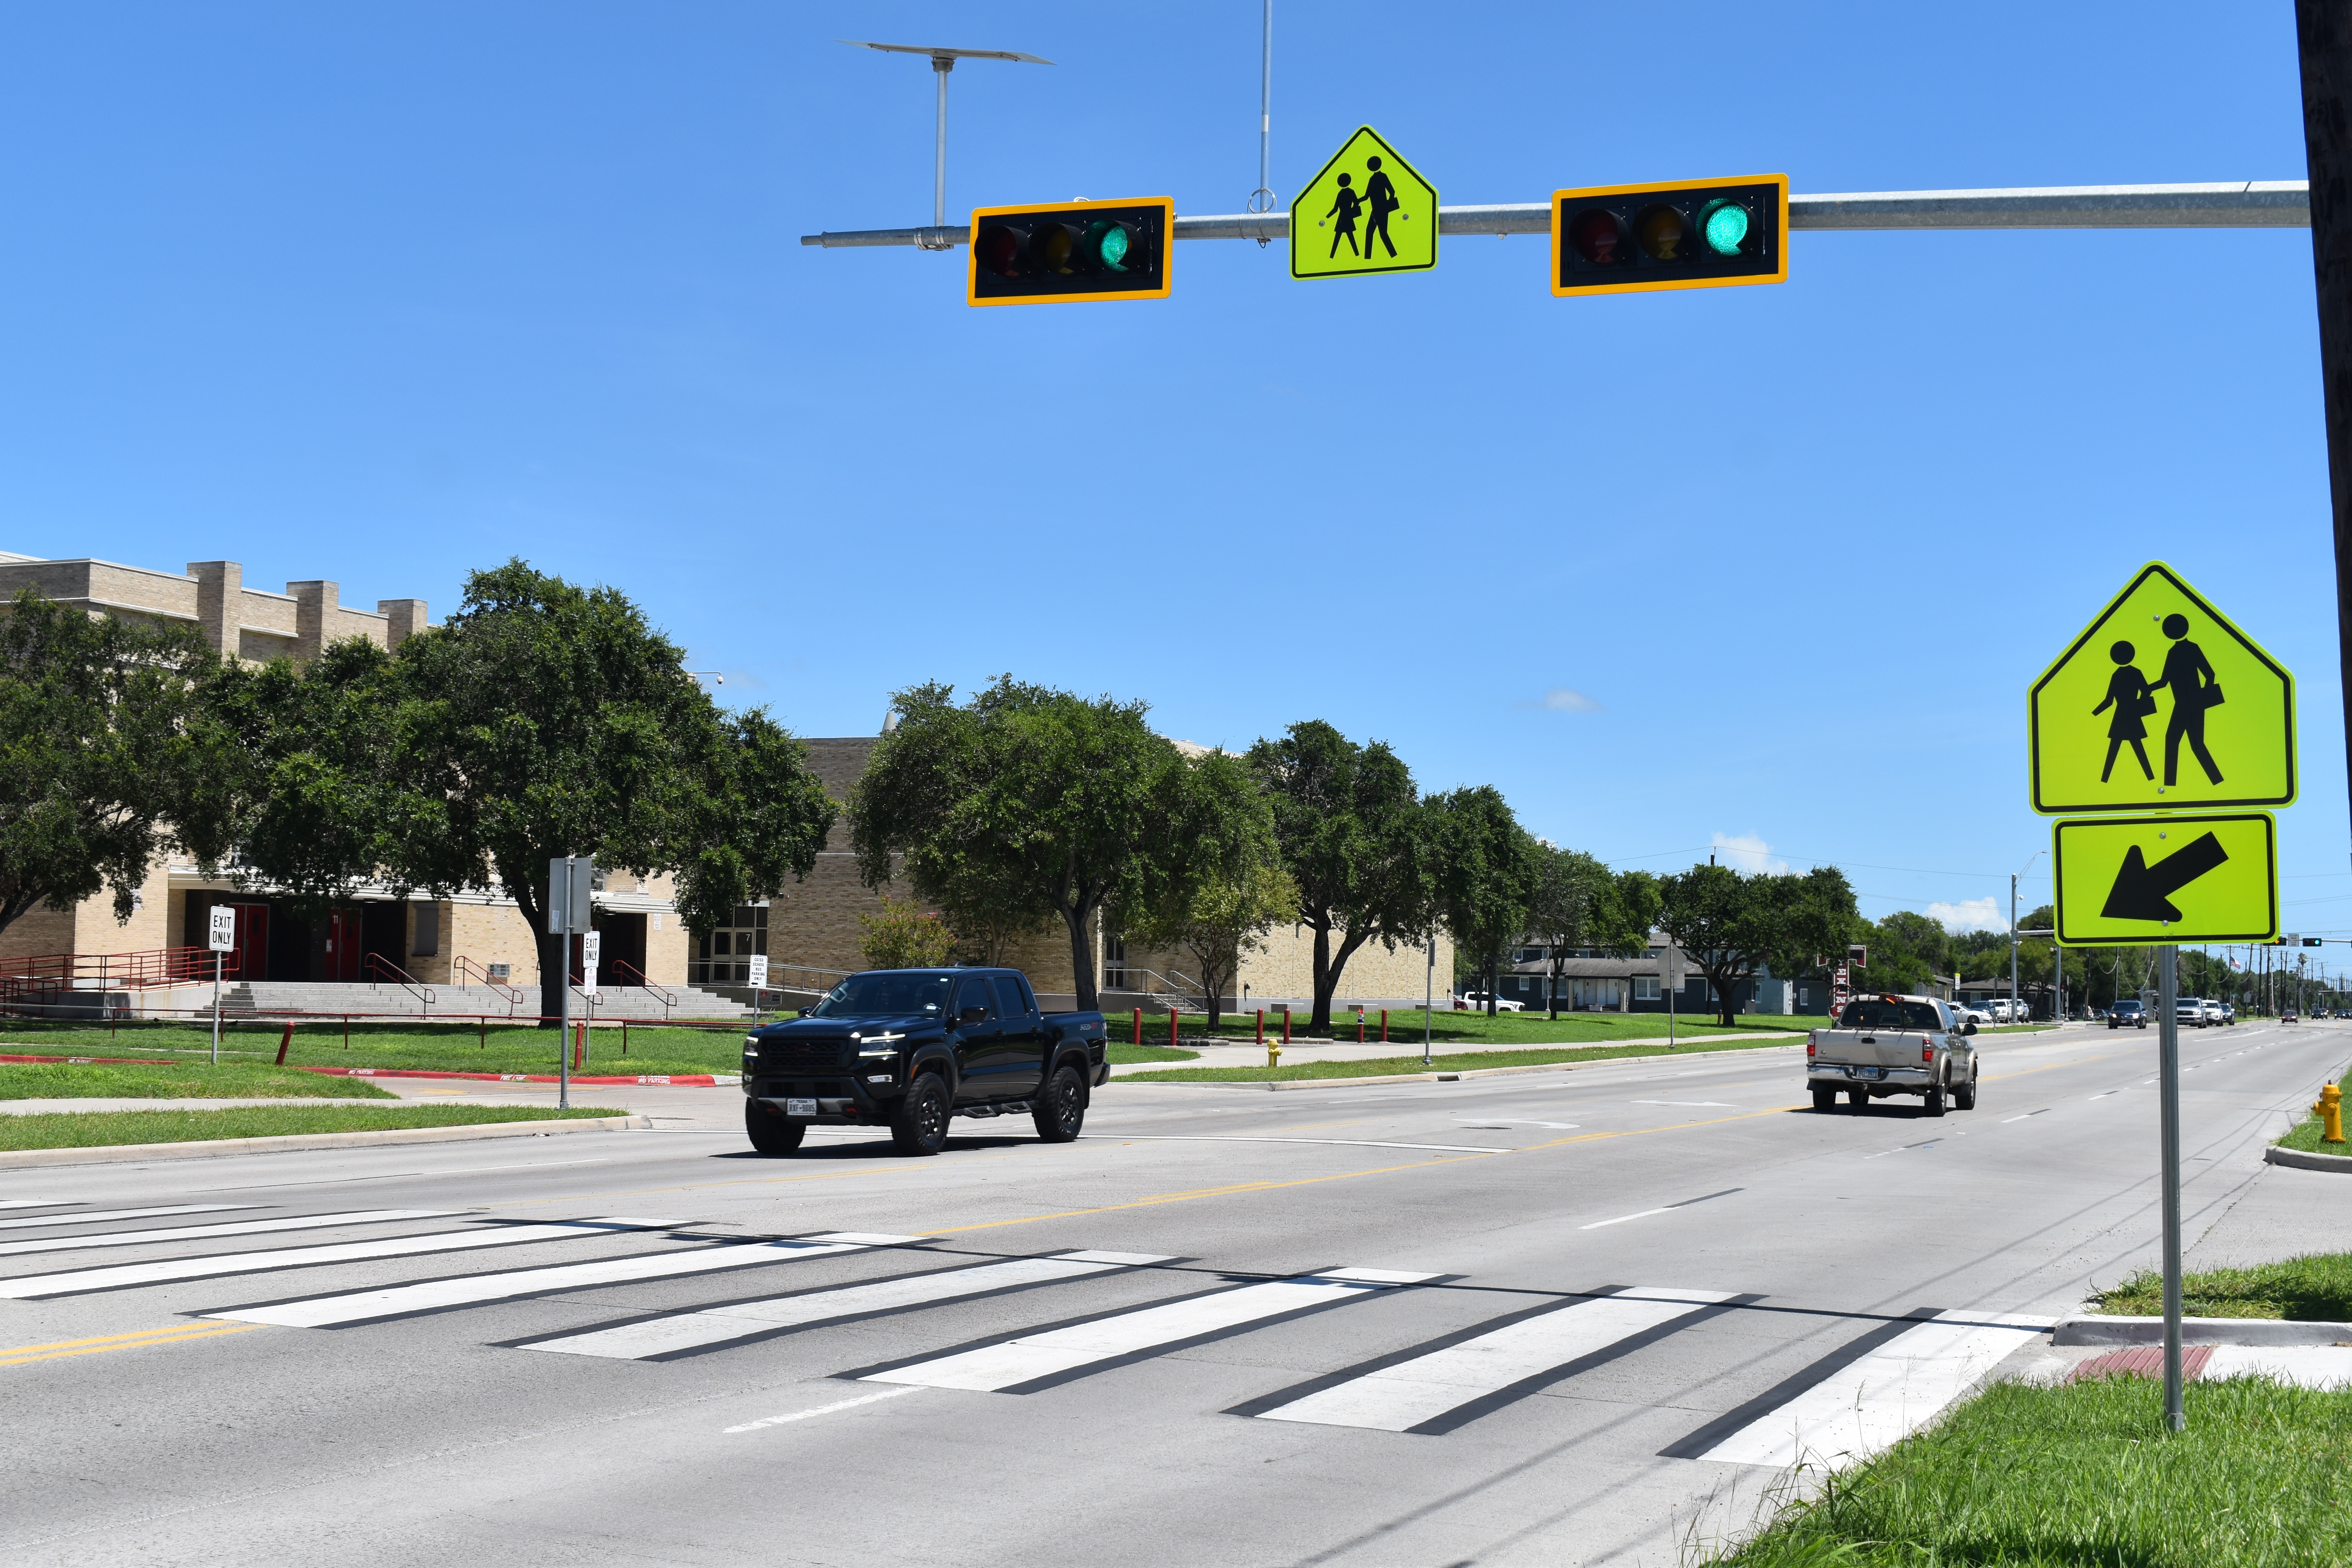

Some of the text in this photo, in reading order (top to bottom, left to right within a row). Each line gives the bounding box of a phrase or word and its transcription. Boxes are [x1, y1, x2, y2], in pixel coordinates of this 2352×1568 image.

[214, 915, 231, 929] EXIT
[332, 914, 338, 924] 11
[212, 931, 231, 944] ONLY
[586, 938, 597, 949] EXIT
[585, 950, 597, 960] ONLY
